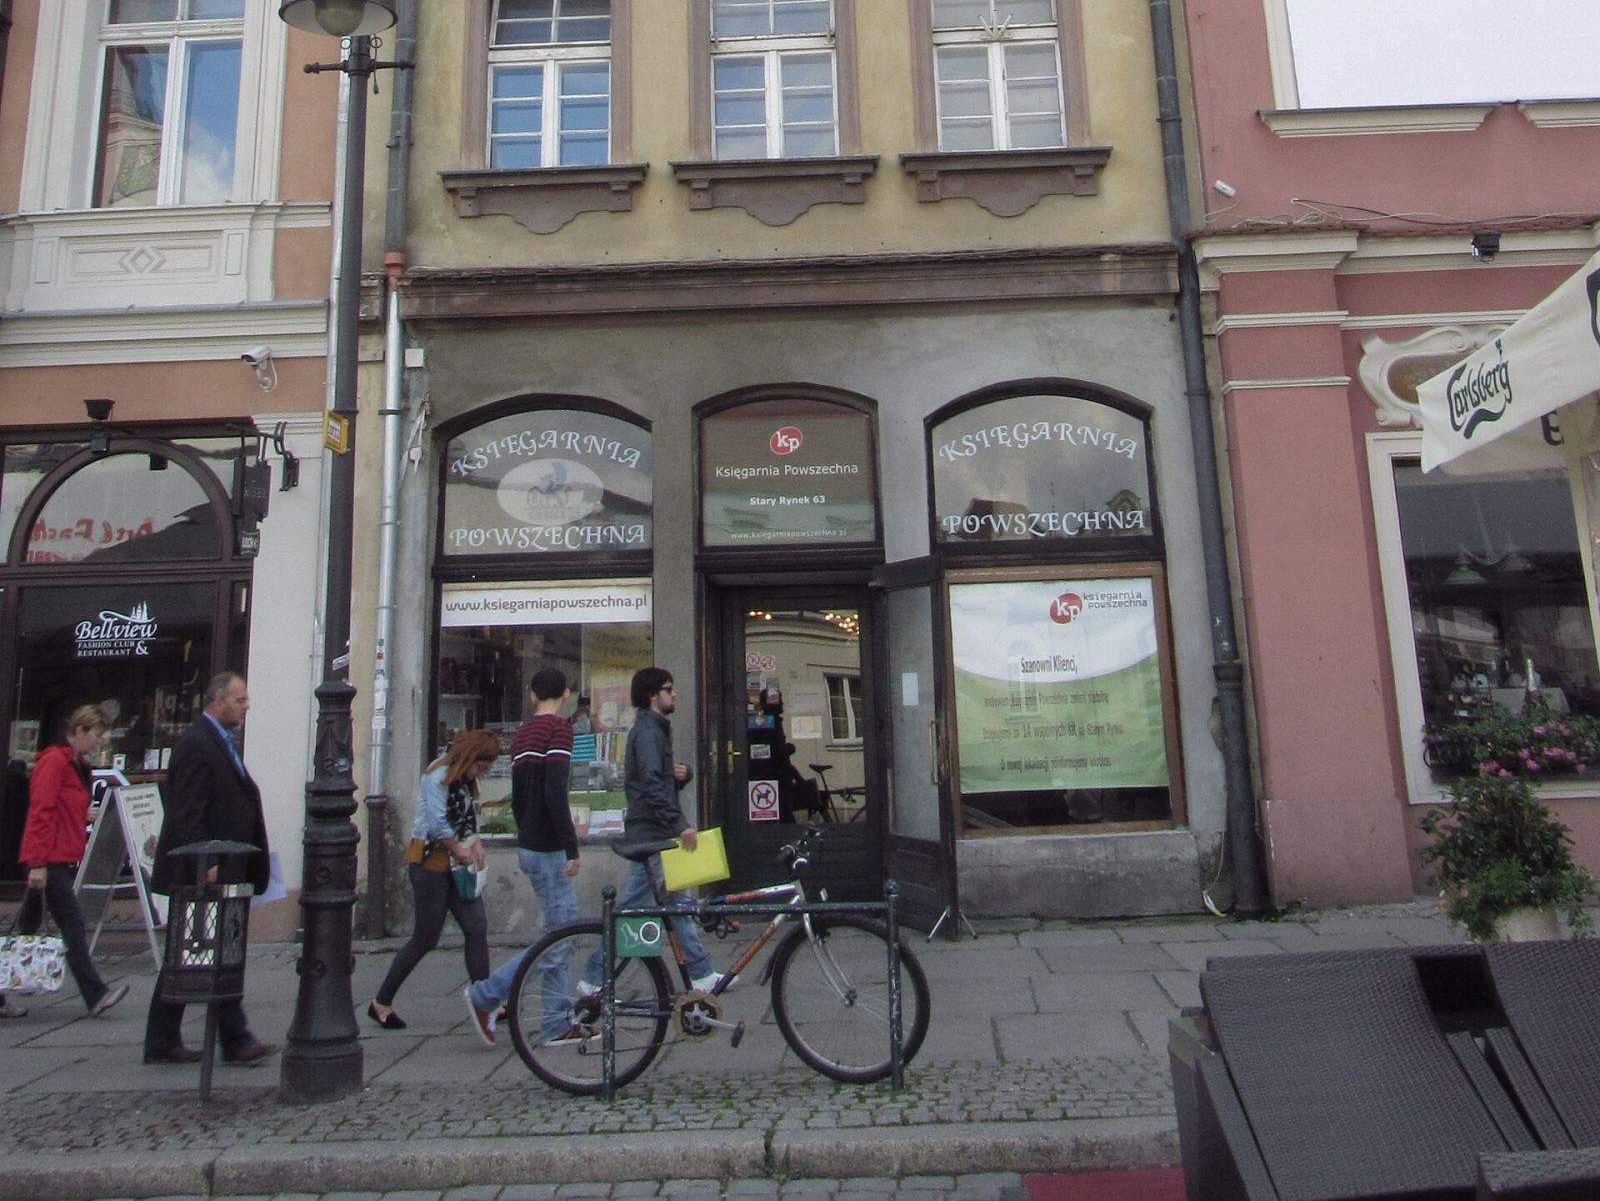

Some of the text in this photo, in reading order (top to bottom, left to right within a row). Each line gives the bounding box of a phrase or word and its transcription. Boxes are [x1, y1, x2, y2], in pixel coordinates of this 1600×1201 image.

[1446, 359, 1513, 439] Carlsberg
[776, 431, 800, 453] kp
[939, 421, 1138, 463] KSIĘGARNIA
[451, 429, 642, 478] KSIĘGARNIA
[715, 463, 859, 480] Księgarnia Powszechna
[750, 495, 826, 507] Stary Rynek 63
[943, 509, 1145, 537] POWSZECHNA
[450, 523, 646, 550] POWSZECHNA
[445, 594, 648, 614] www.ksiegarniapowszechna.pl
[1055, 598, 1081, 620] kp
[1087, 598, 1148, 609] powszechna
[75, 611, 158, 640] Bellview
[77, 640, 150, 655] FASHION CLUB &
[77, 648, 131, 657] RESTAURANT
[1020, 654, 1052, 674] Szanowni
